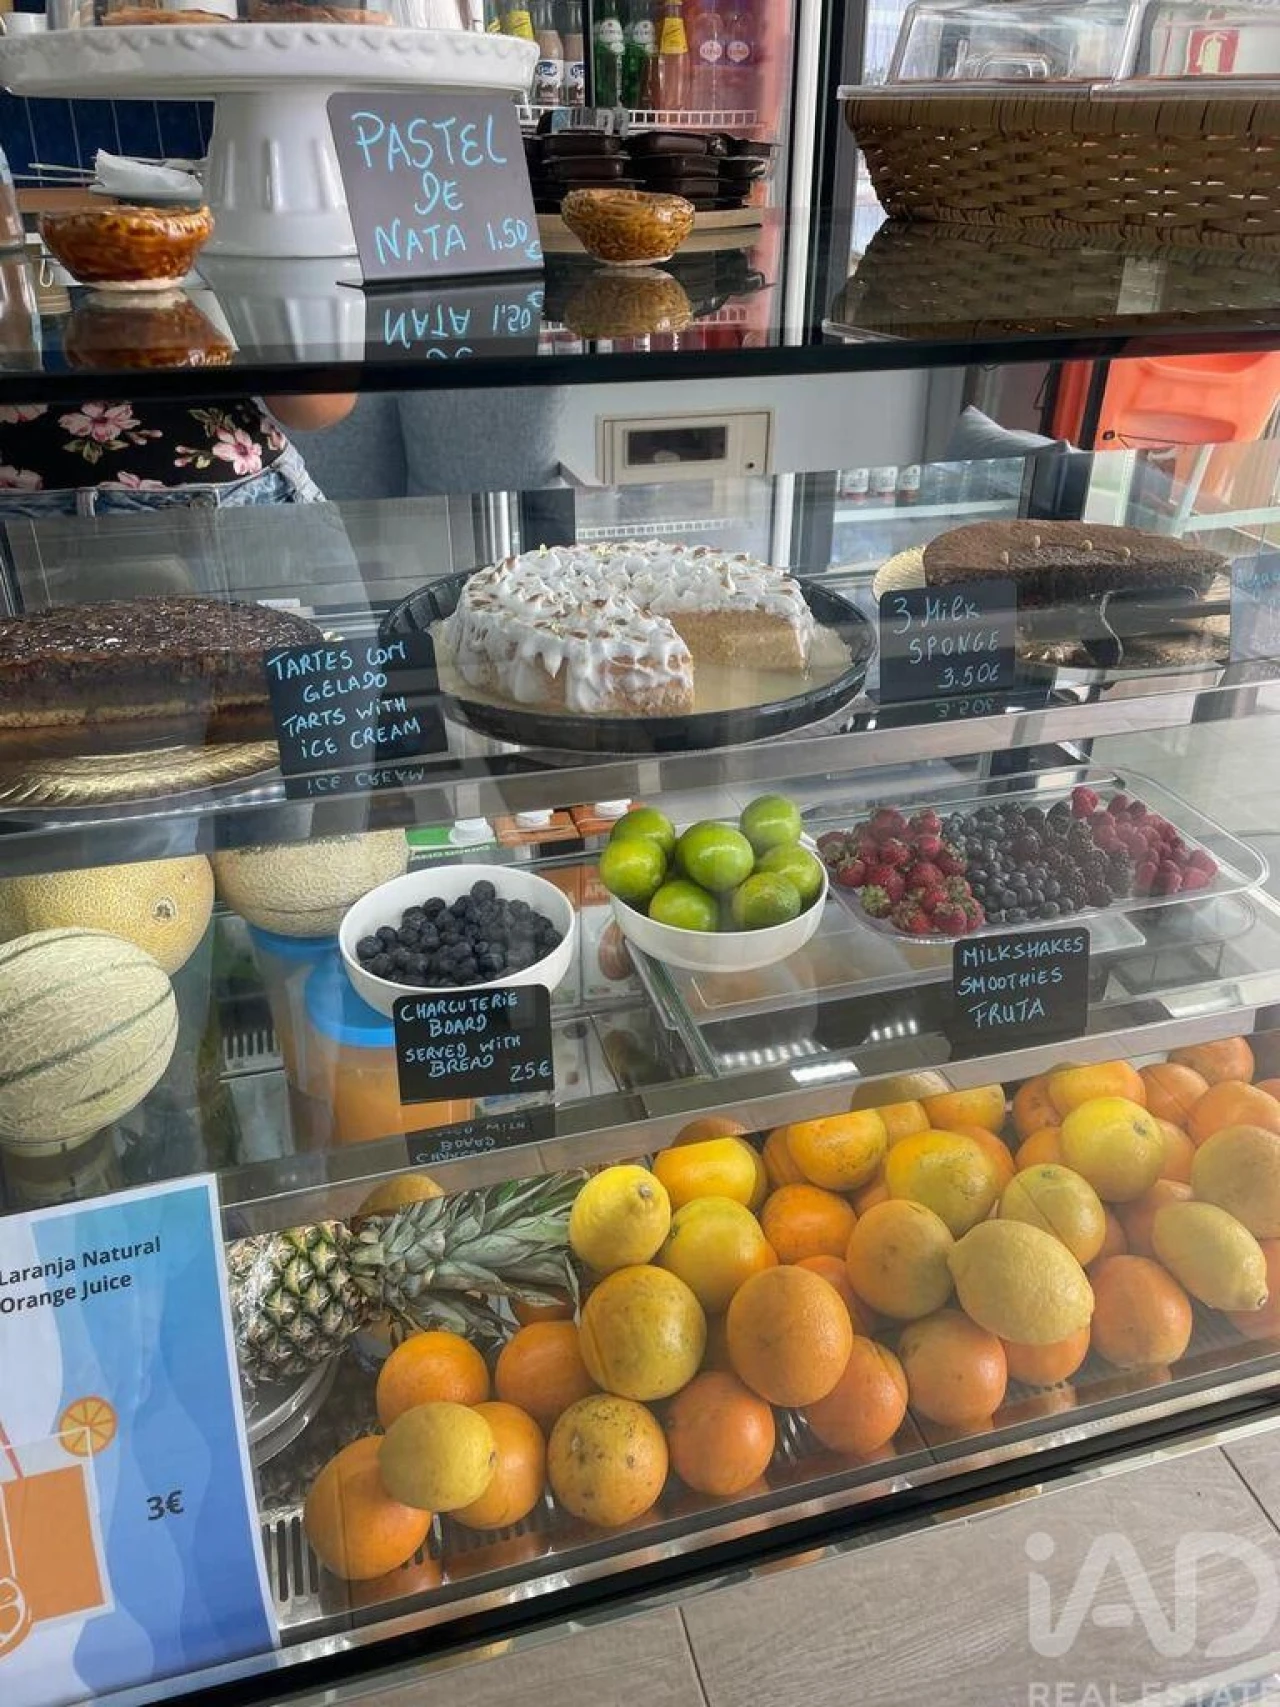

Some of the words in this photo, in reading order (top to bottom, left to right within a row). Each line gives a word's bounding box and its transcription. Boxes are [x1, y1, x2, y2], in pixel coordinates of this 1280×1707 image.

[351, 112, 507, 171] PASTEL
[414, 171, 463, 215] DE
[374, 218, 466, 265] NATA
[893, 597, 912, 634] 3
[909, 630, 999, 664] SPONGE
[267, 650, 352, 681] TARTES
[303, 671, 388, 703] GELADO
[282, 708, 346, 737] TARTS
[350, 716, 421, 749] CREAM
[429, 1014, 487, 1038] BOARD
[968, 997, 1045, 1028] FRUTA
[405, 1042, 467, 1063] SERVED
[428, 1054, 494, 1078] BREAD
[509, 1060, 551, 1082] 25€
[0, 1256, 76, 1286] Laranja
[83, 1235, 161, 1268] Natural
[0, 1285, 76, 1313] Orange
[81, 1274, 132, 1301] Juice
[146, 1490, 184, 1521] 3€
